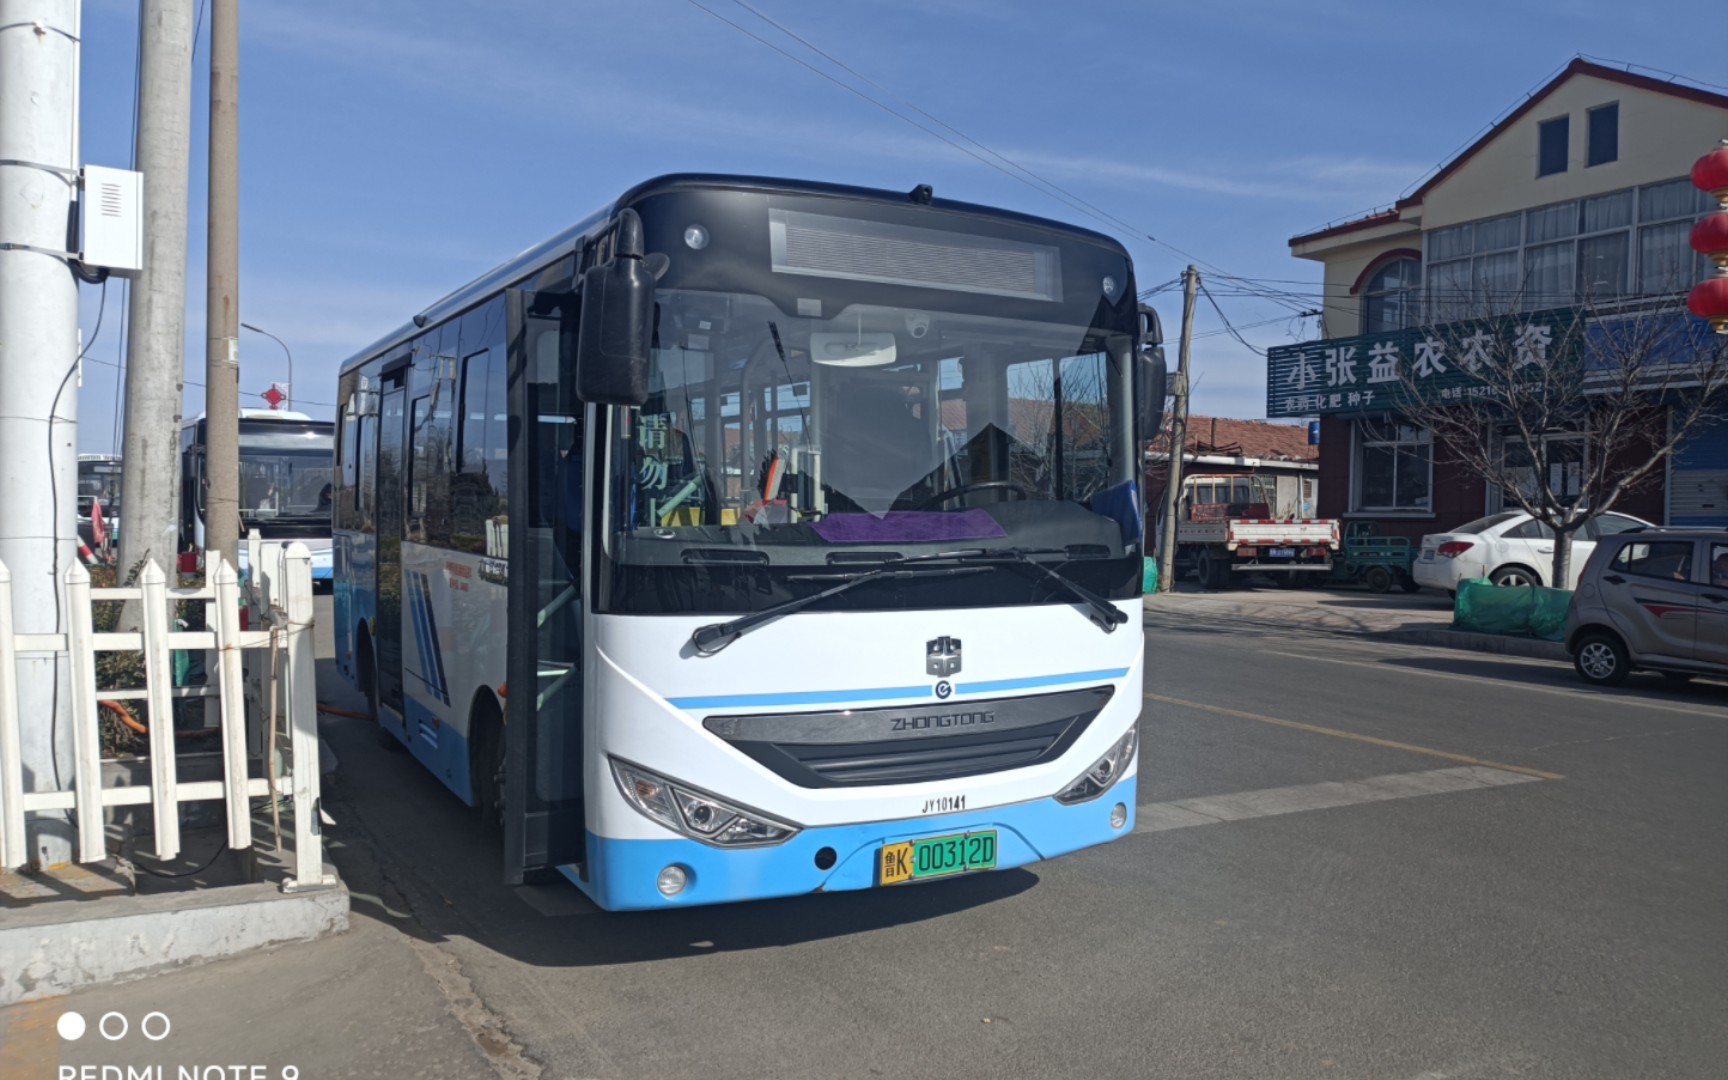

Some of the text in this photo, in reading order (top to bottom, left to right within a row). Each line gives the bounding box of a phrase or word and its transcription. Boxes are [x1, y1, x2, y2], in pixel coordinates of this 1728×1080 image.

[1286, 324, 1552, 390] 小张益农农资
[1347, 390, 1376, 407] 种子
[891, 711, 995, 731] ZHONGTONG
[922, 795, 966, 813] JY10141
